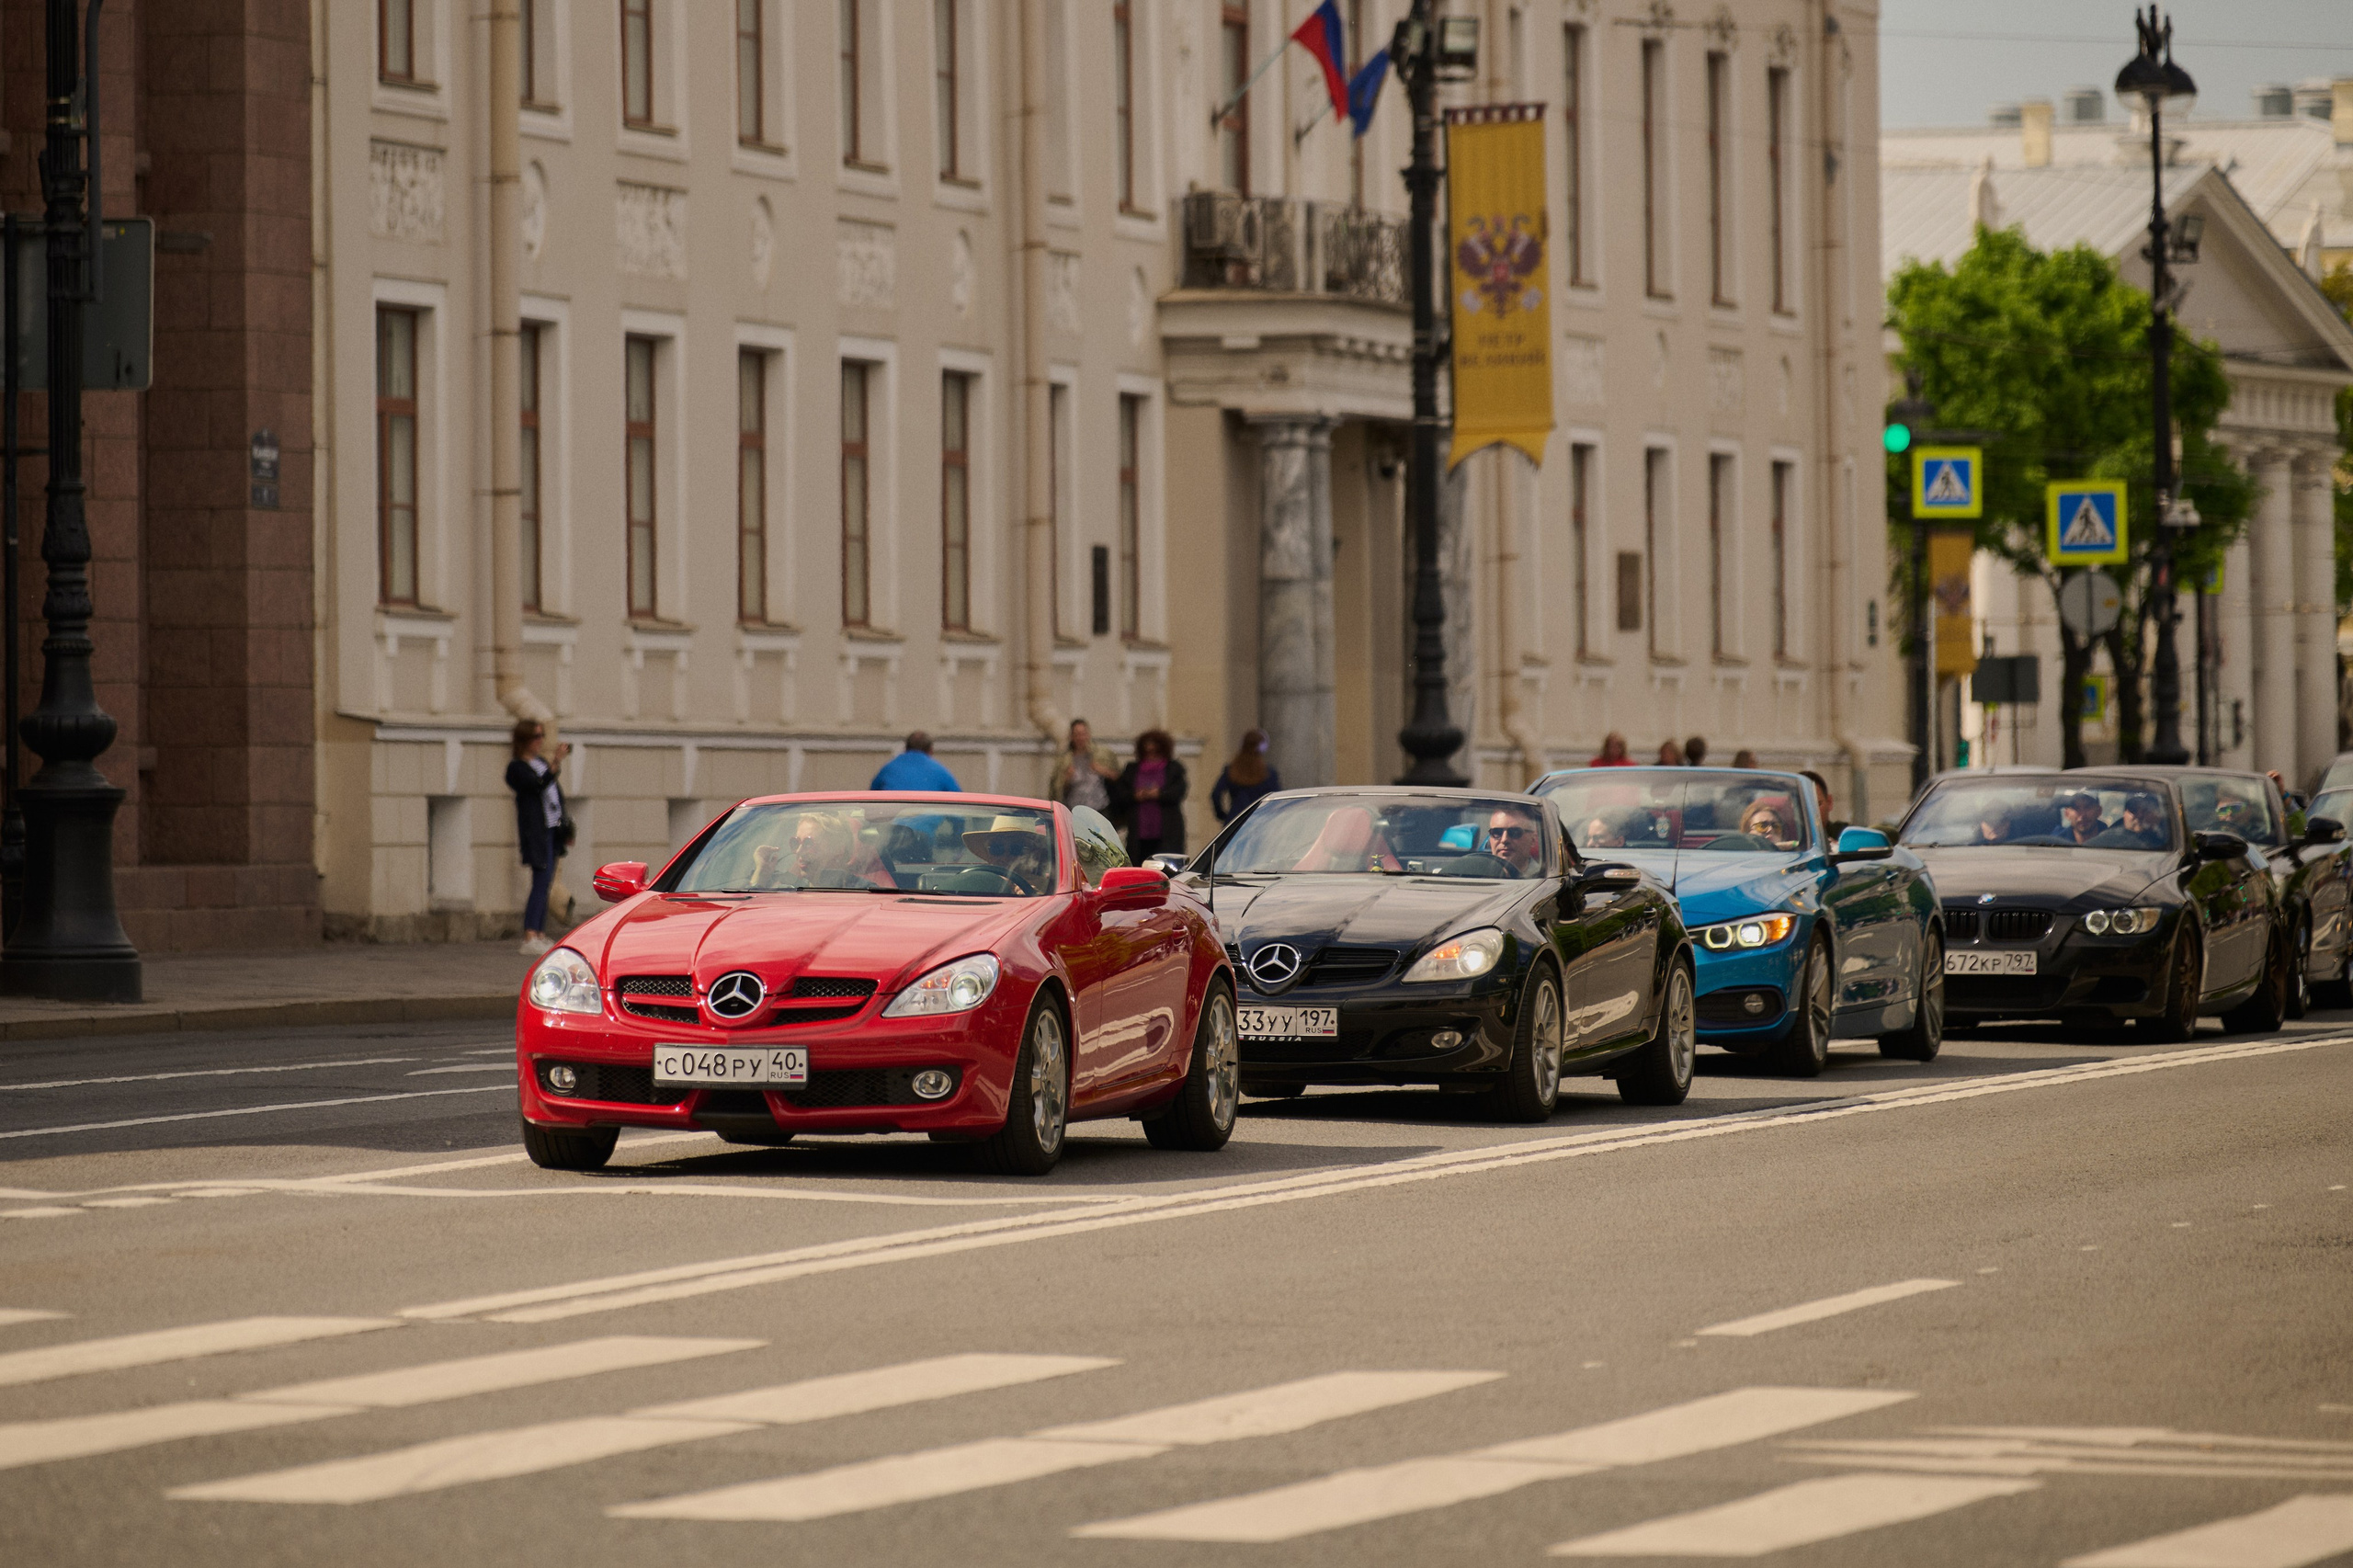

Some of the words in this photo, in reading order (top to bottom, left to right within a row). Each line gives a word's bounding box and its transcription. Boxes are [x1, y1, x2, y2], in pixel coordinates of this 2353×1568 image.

[1946, 954, 2002, 971] 672КР
[2005, 953, 2031, 967] 797
[1238, 1009, 1293, 1033] 33УУ
[1299, 1009, 1331, 1027] 197
[665, 1051, 762, 1078] С048РУ
[772, 1051, 797, 1071] 40
